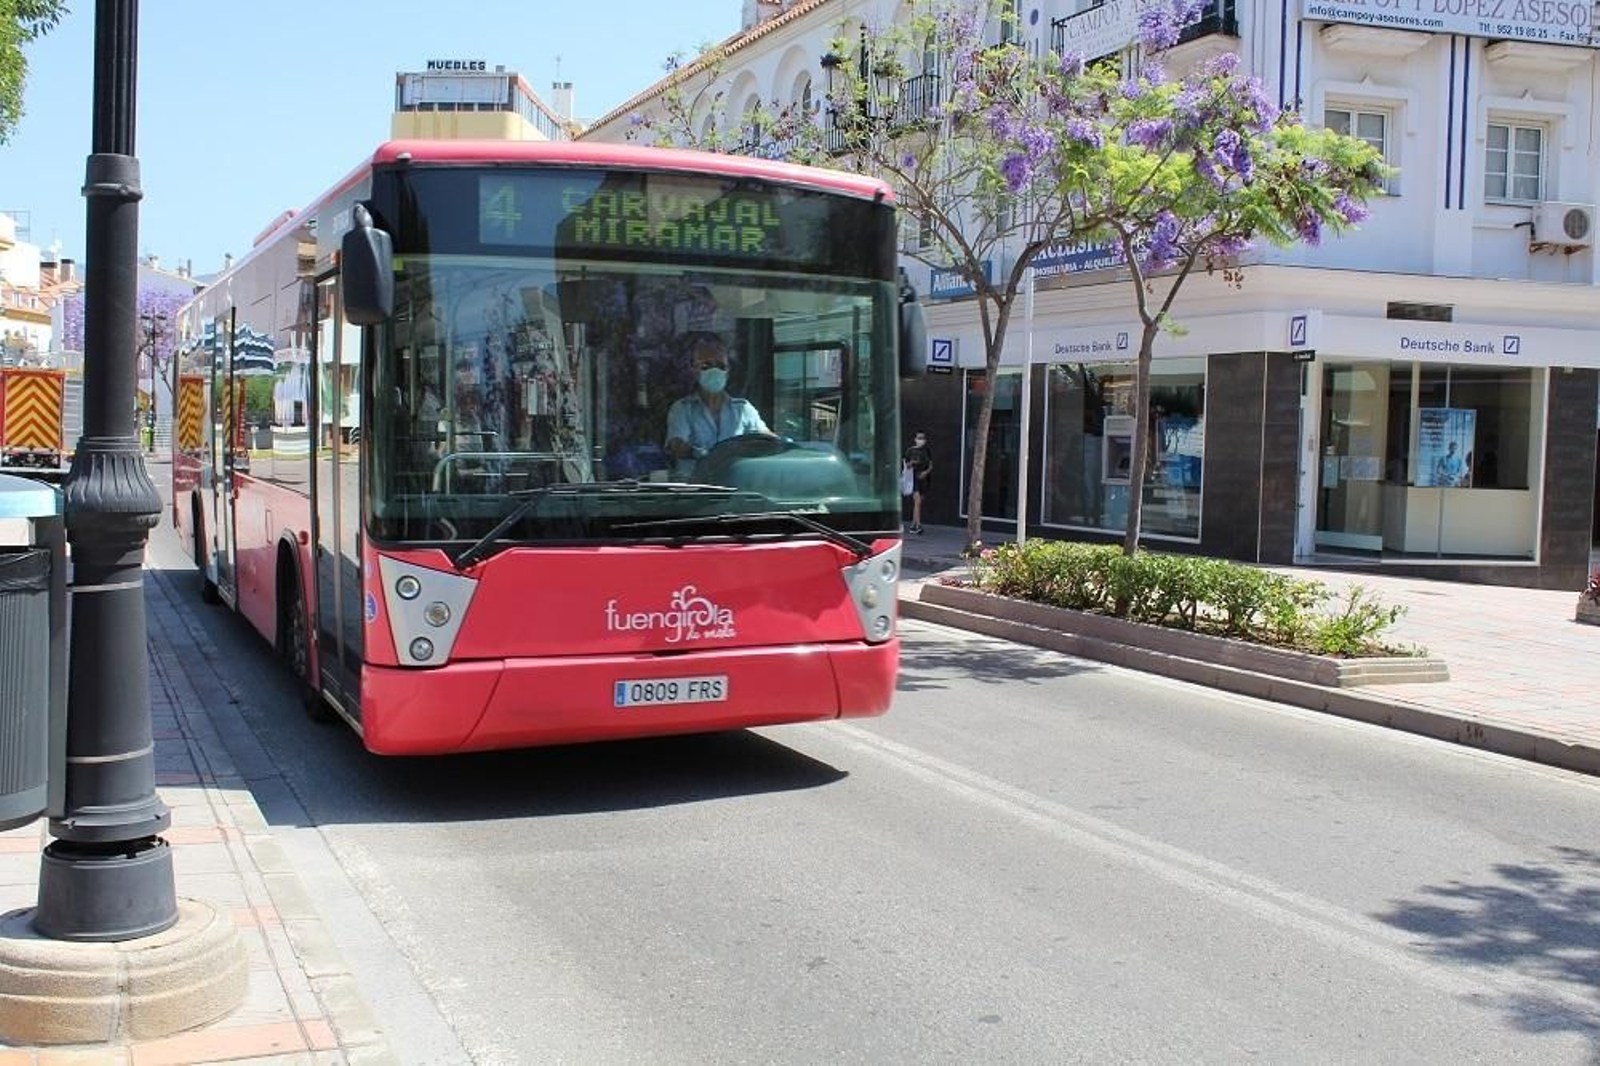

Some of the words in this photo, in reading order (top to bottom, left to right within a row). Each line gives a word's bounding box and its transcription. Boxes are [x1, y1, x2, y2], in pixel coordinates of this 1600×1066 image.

[1512, 0, 1595, 28] ASESO
[427, 60, 486, 71] MUEBLES
[484, 182, 522, 237] 4
[561, 186, 780, 227] CARVAJAL
[574, 216, 767, 251] MIRAMAR
[1055, 343, 1090, 354] Deutsche
[1092, 340, 1113, 352] Bank
[1400, 337, 1460, 352] Deutsche
[1464, 340, 1495, 354] Bank
[604, 586, 735, 642] fuengirola
[631, 682, 679, 702] 0809
[688, 681, 722, 699] FRS
